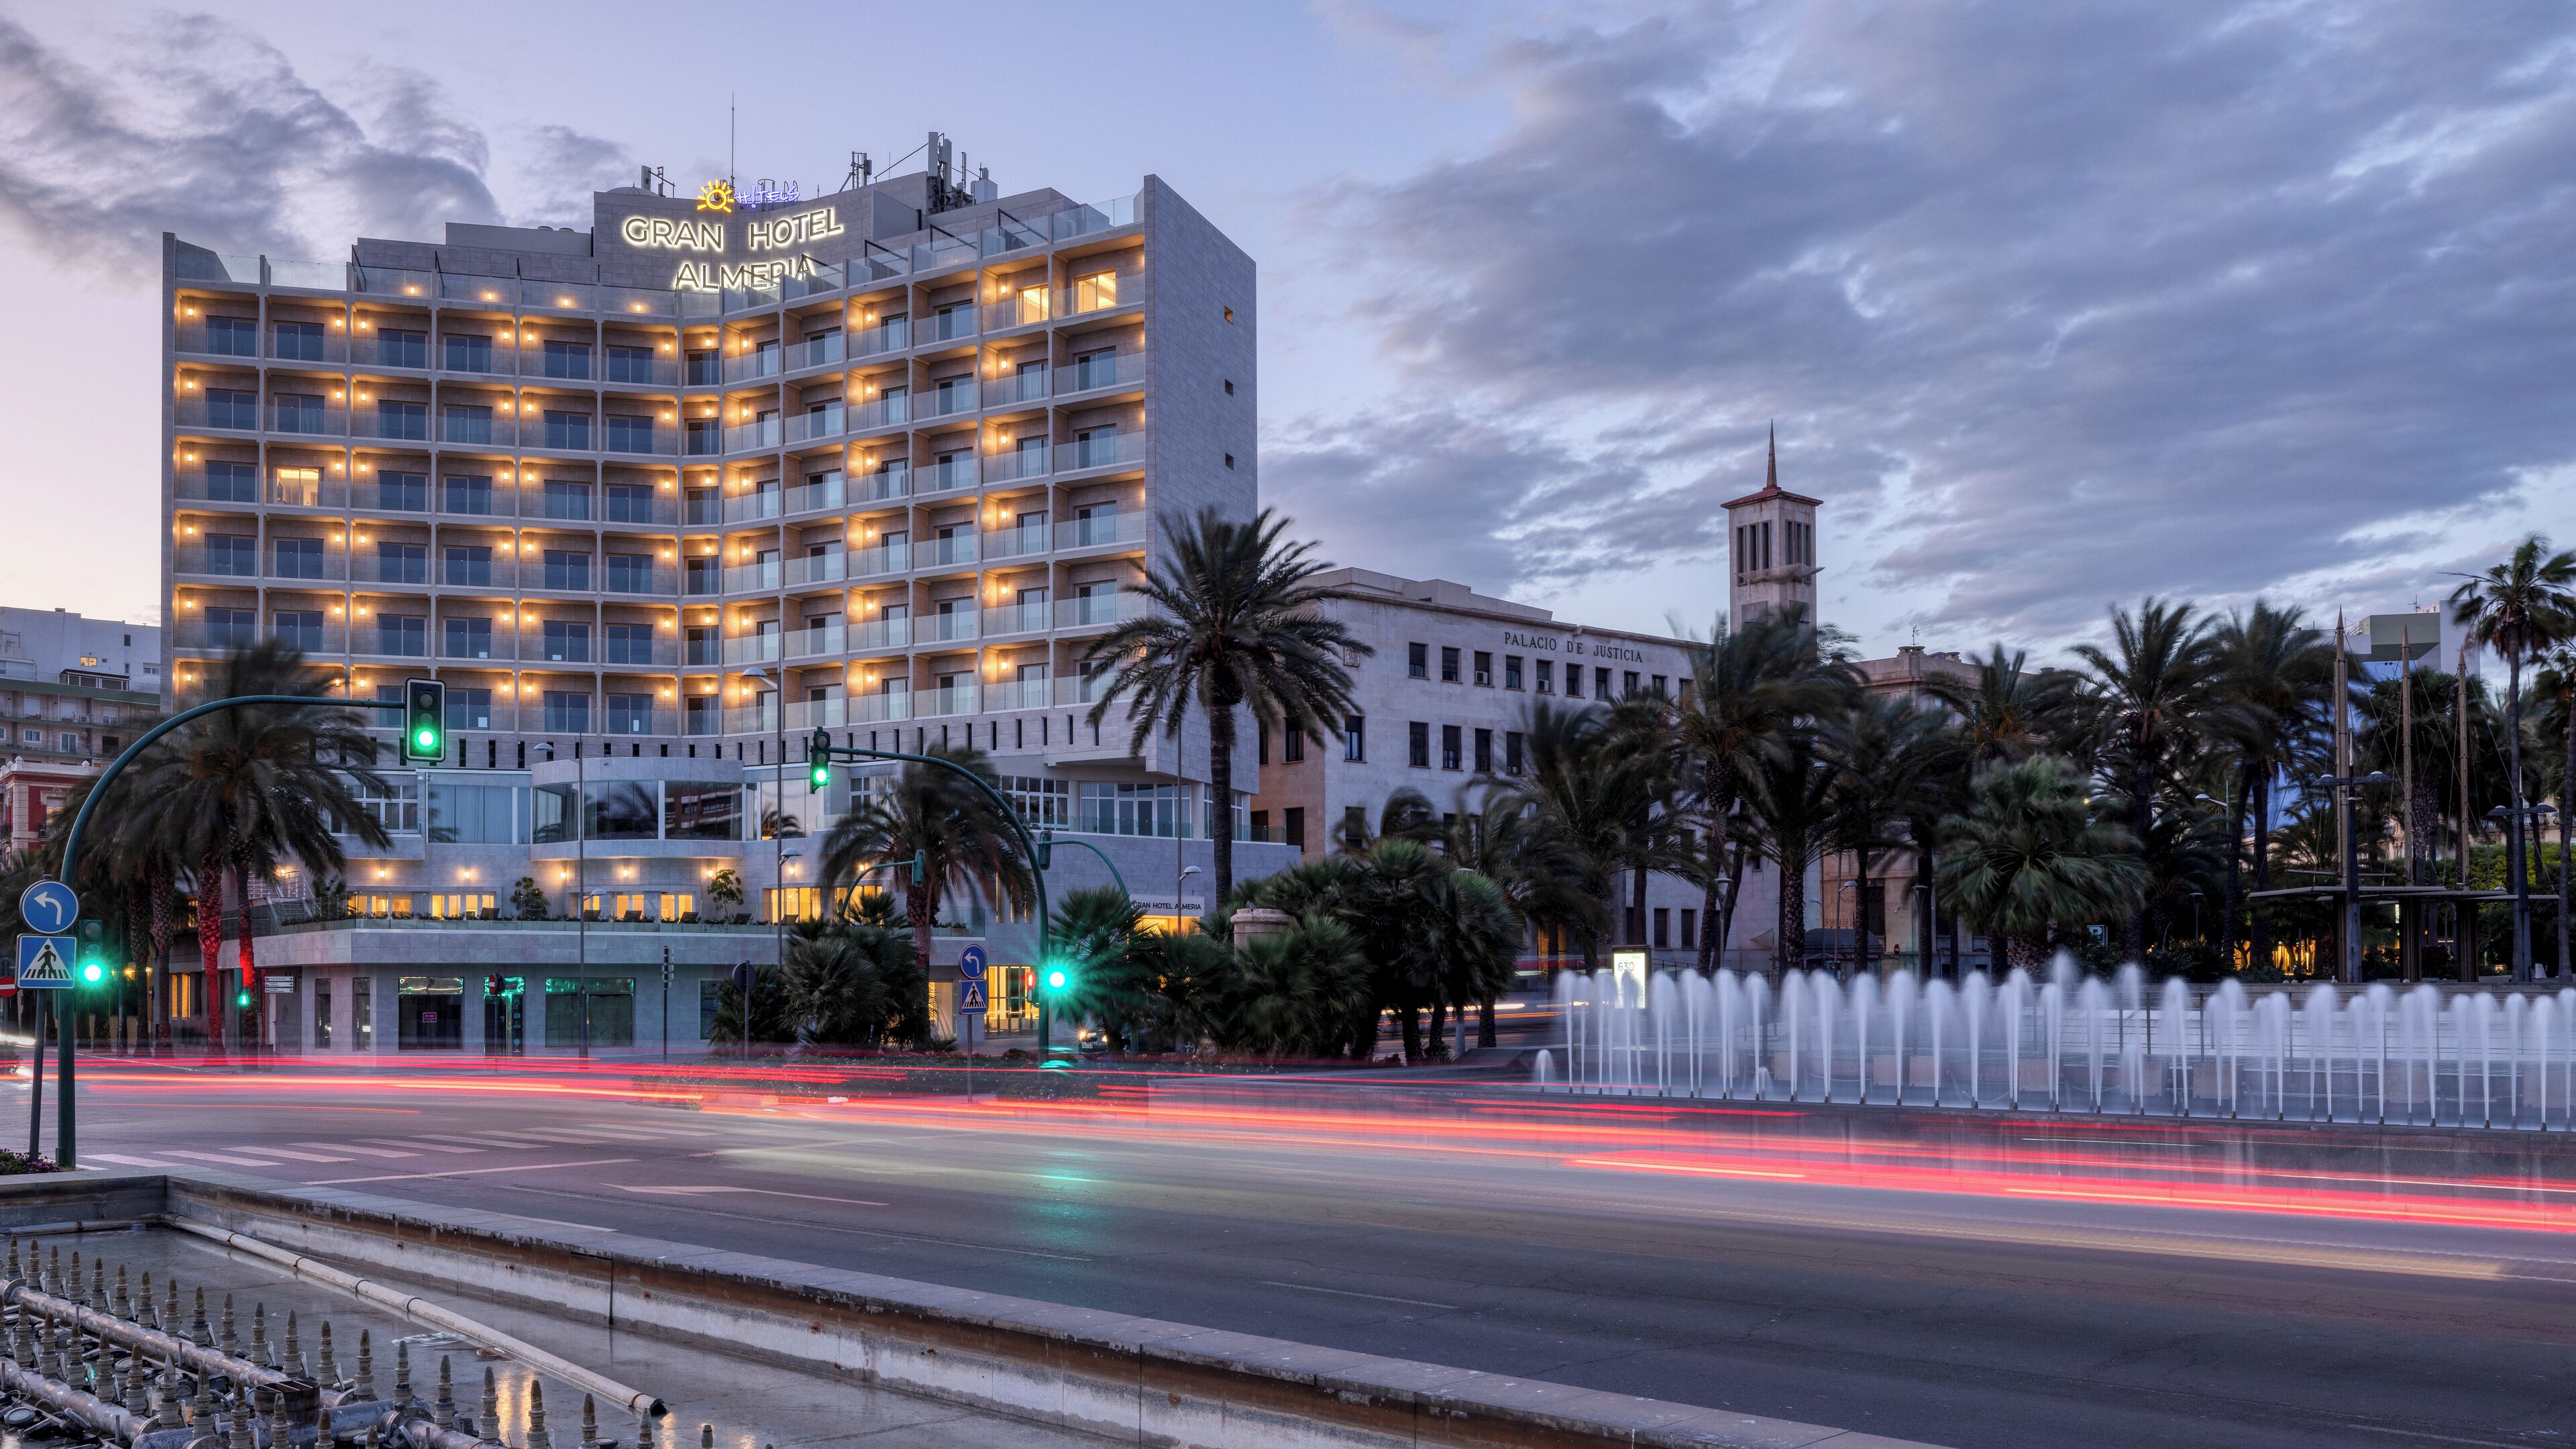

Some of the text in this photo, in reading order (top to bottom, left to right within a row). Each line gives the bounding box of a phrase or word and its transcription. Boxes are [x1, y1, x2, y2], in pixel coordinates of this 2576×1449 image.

[625, 209, 841, 250] GRAN HOTEL
[1504, 632, 1643, 663] PALACIO DE JUSTICIA
[1617, 961, 1635, 971] 630
